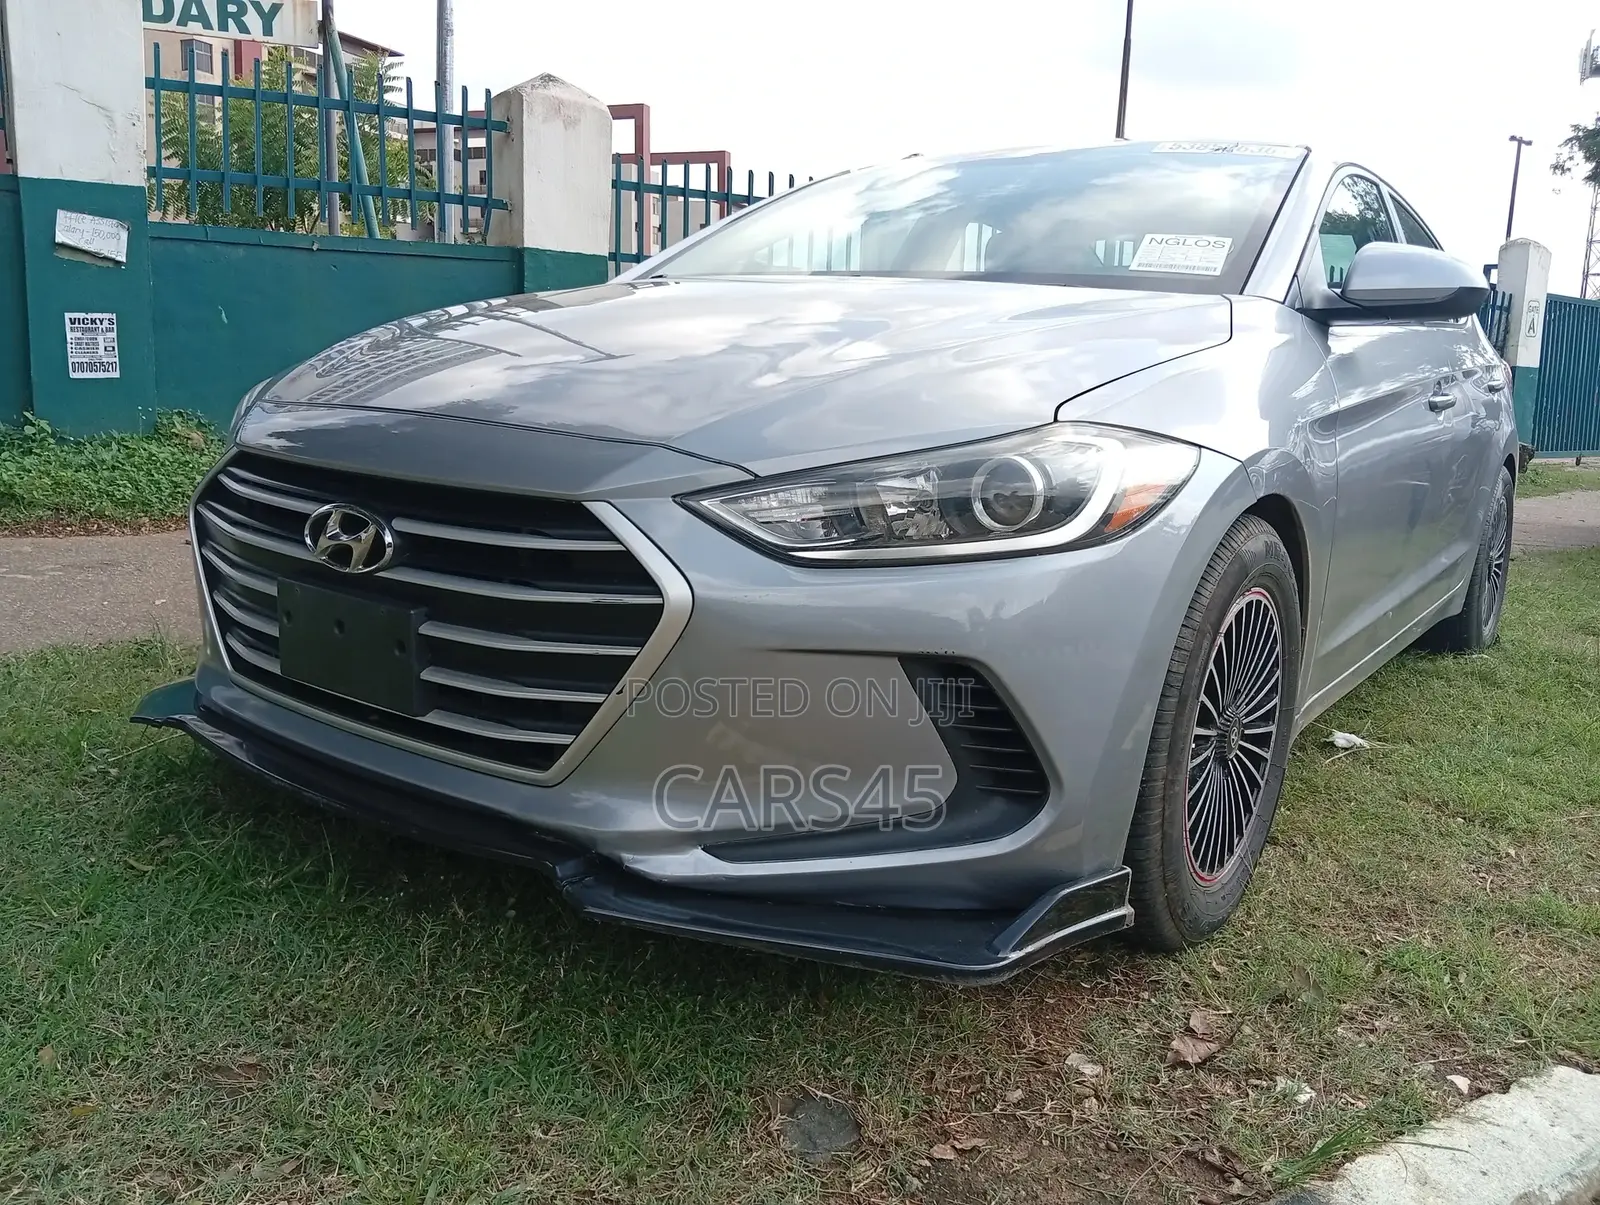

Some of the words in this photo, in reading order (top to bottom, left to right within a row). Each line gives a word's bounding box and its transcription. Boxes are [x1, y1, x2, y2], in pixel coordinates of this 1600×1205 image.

[143, 0, 284, 37] DARY
[1148, 237, 1226, 249] NGLOS
[69, 317, 115, 326] VICKY'S
[1527, 317, 1536, 334] A
[71, 361, 117, 373] 07070575217
